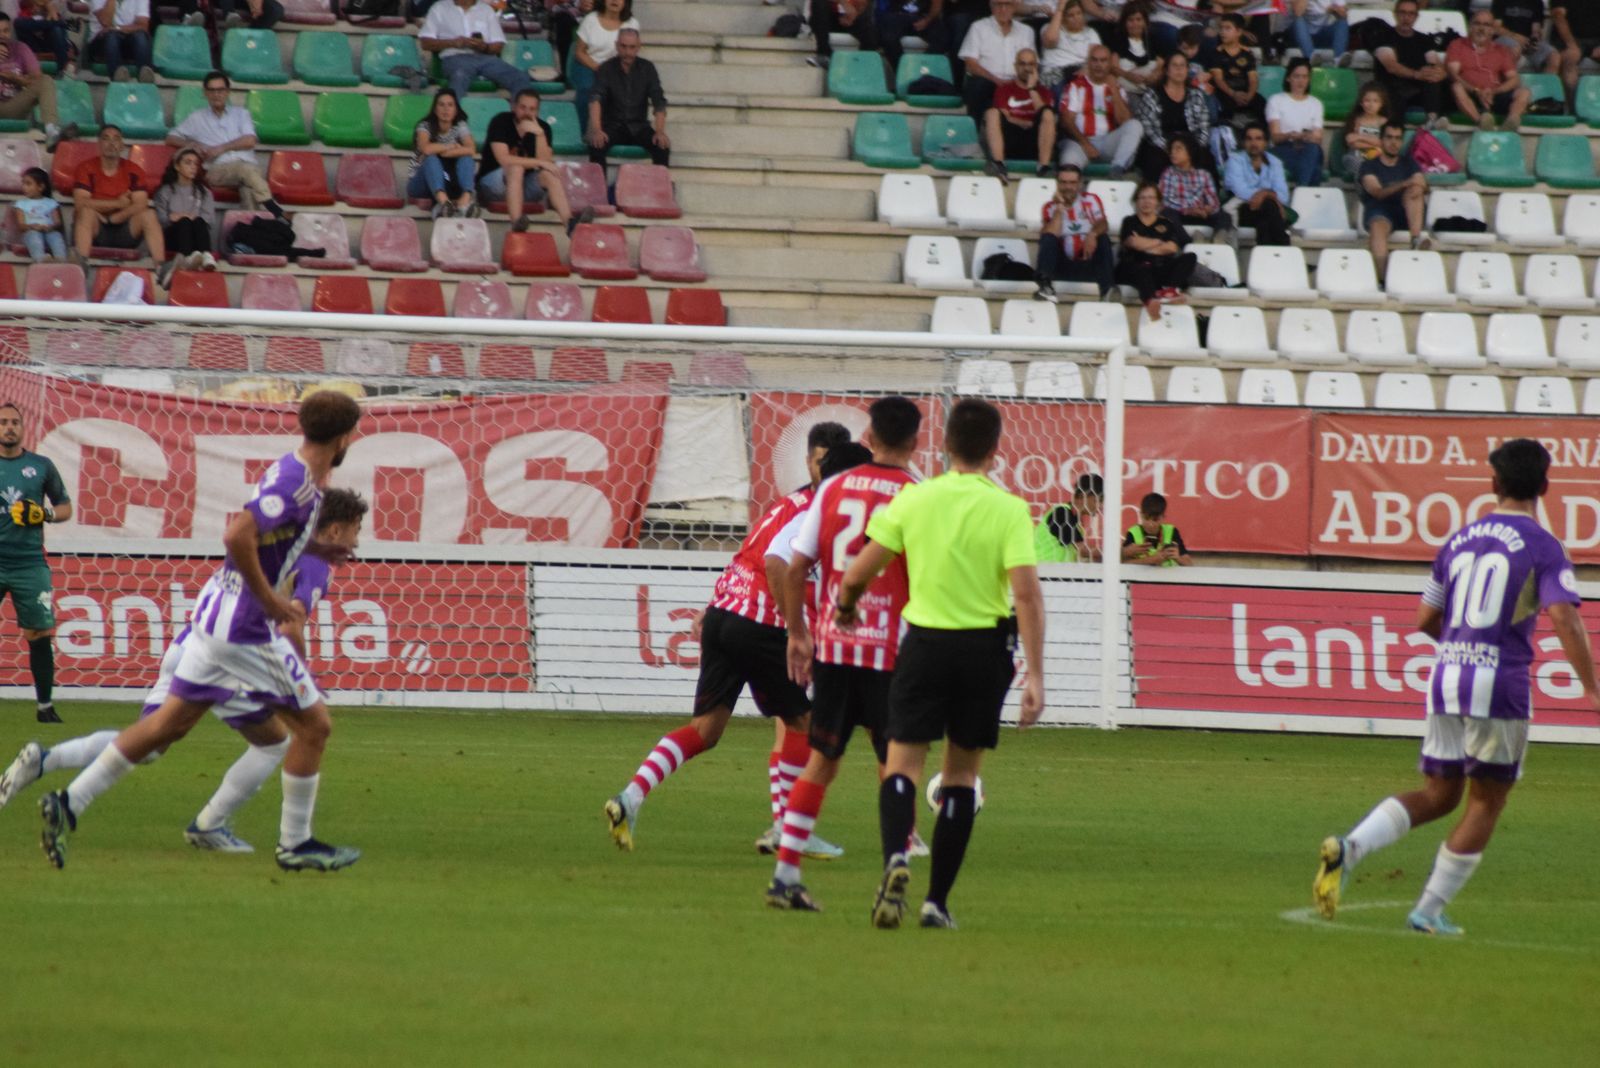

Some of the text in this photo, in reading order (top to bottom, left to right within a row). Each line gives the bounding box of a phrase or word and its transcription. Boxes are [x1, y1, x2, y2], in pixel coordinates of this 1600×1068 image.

[1319, 431, 1433, 465] DAVID
[1440, 436, 1477, 466] A.
[1318, 490, 1600, 549] ABOD
[1449, 551, 1510, 629] 10
[1231, 603, 1586, 700] lantaa
